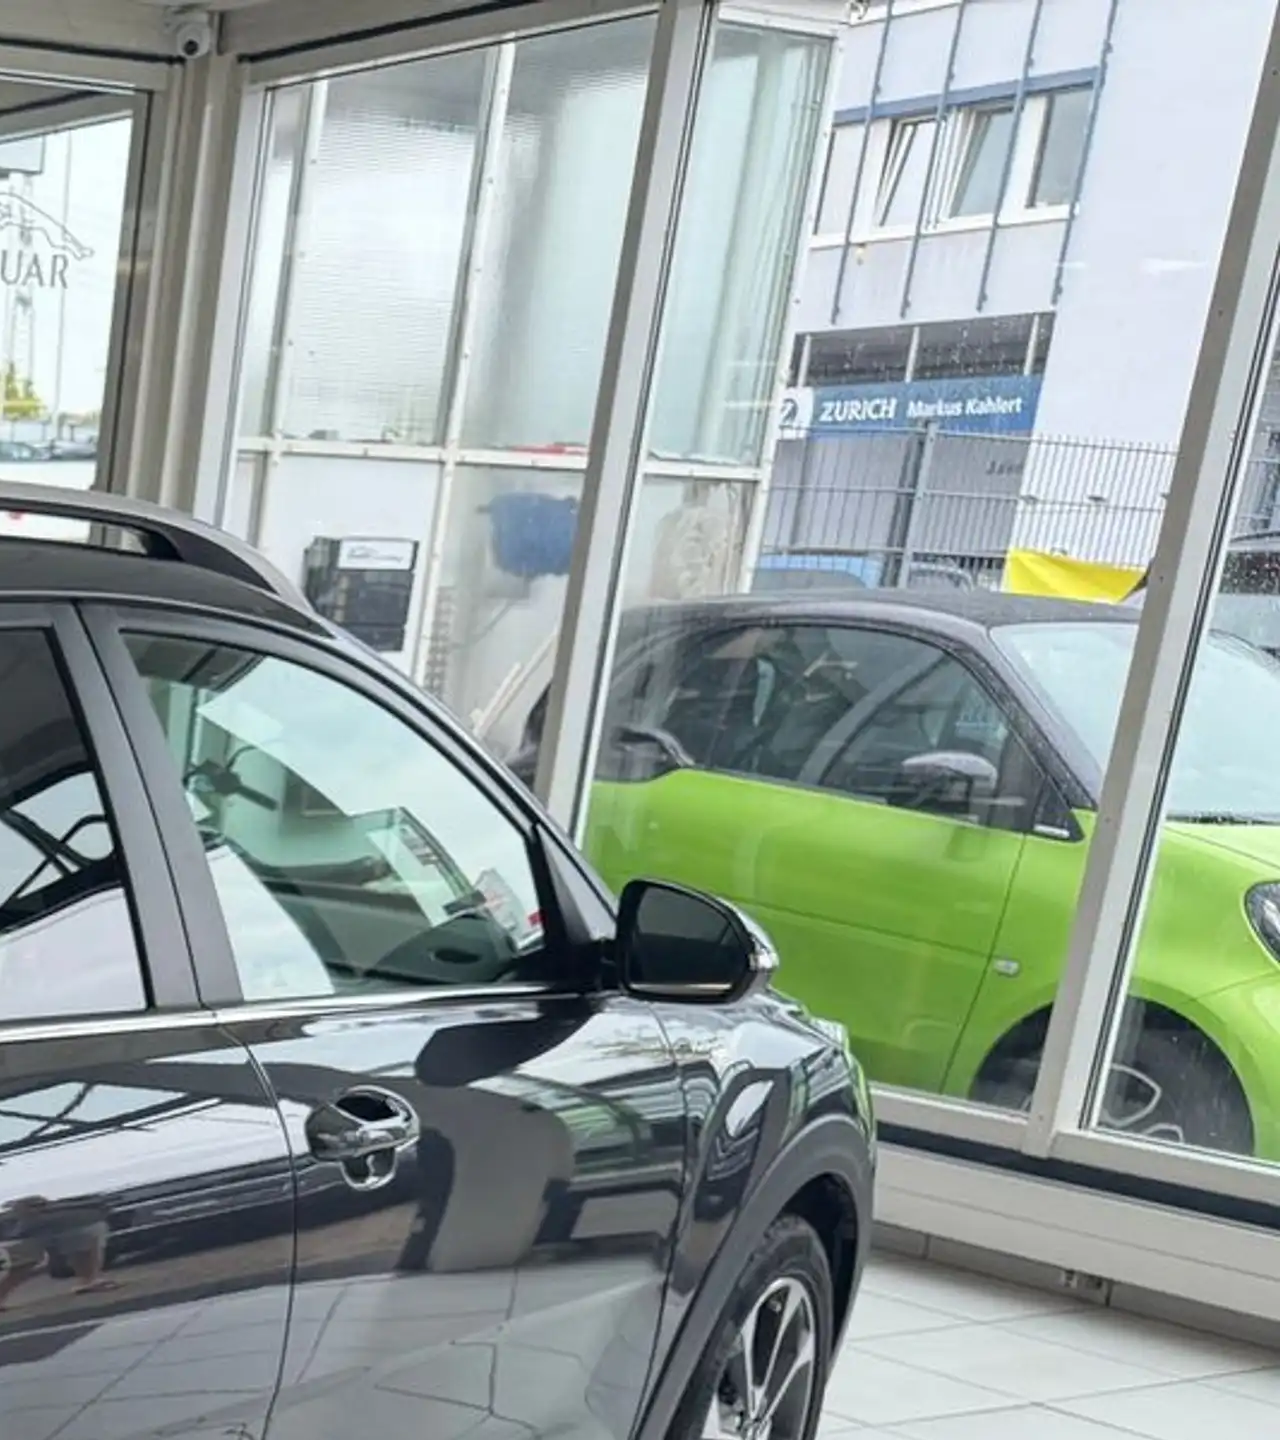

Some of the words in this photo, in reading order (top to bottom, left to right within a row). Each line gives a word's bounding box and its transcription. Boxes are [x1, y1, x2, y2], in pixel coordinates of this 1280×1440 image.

[819, 397, 897, 422] ZURICH
[906, 399, 963, 419] Markus
[965, 396, 1022, 416] Kahlert
